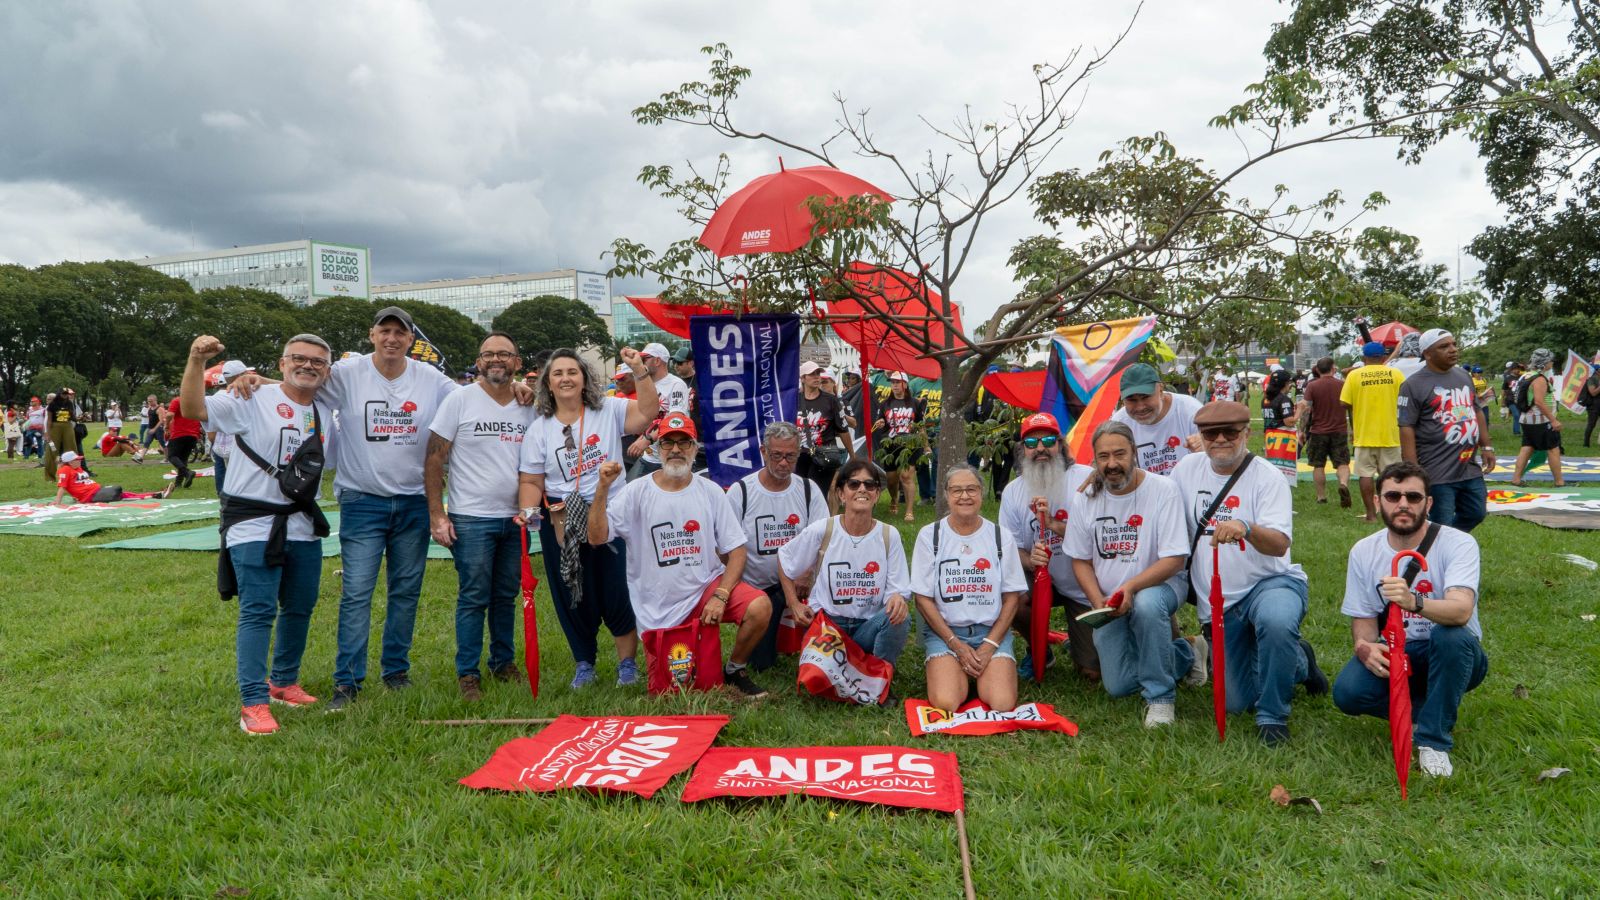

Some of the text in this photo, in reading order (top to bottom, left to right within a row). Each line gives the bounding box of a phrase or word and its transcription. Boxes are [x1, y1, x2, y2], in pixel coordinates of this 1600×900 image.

[741, 229, 771, 240] ANDES
[321, 254, 358, 265] DO LADO
[322, 263, 359, 275] DO POVO
[322, 272, 359, 282] BRASILEIRO
[759, 322, 773, 389] NACIONAL
[708, 323, 753, 469] ANDES
[1433, 385, 1471, 411] FIM
[373, 408, 412, 418] Nas redes
[373, 425, 418, 433] ANDES-SN
[660, 531, 675, 541] Nas
[667, 539, 681, 547] nas
[836, 571, 875, 579] Nas redes
[945, 567, 985, 576] Nas redes
[952, 576, 967, 584] nas
[836, 588, 880, 596] ANDES-SN
[946, 585, 993, 594] ANDES-SN
[723, 753, 935, 782] ANDES
